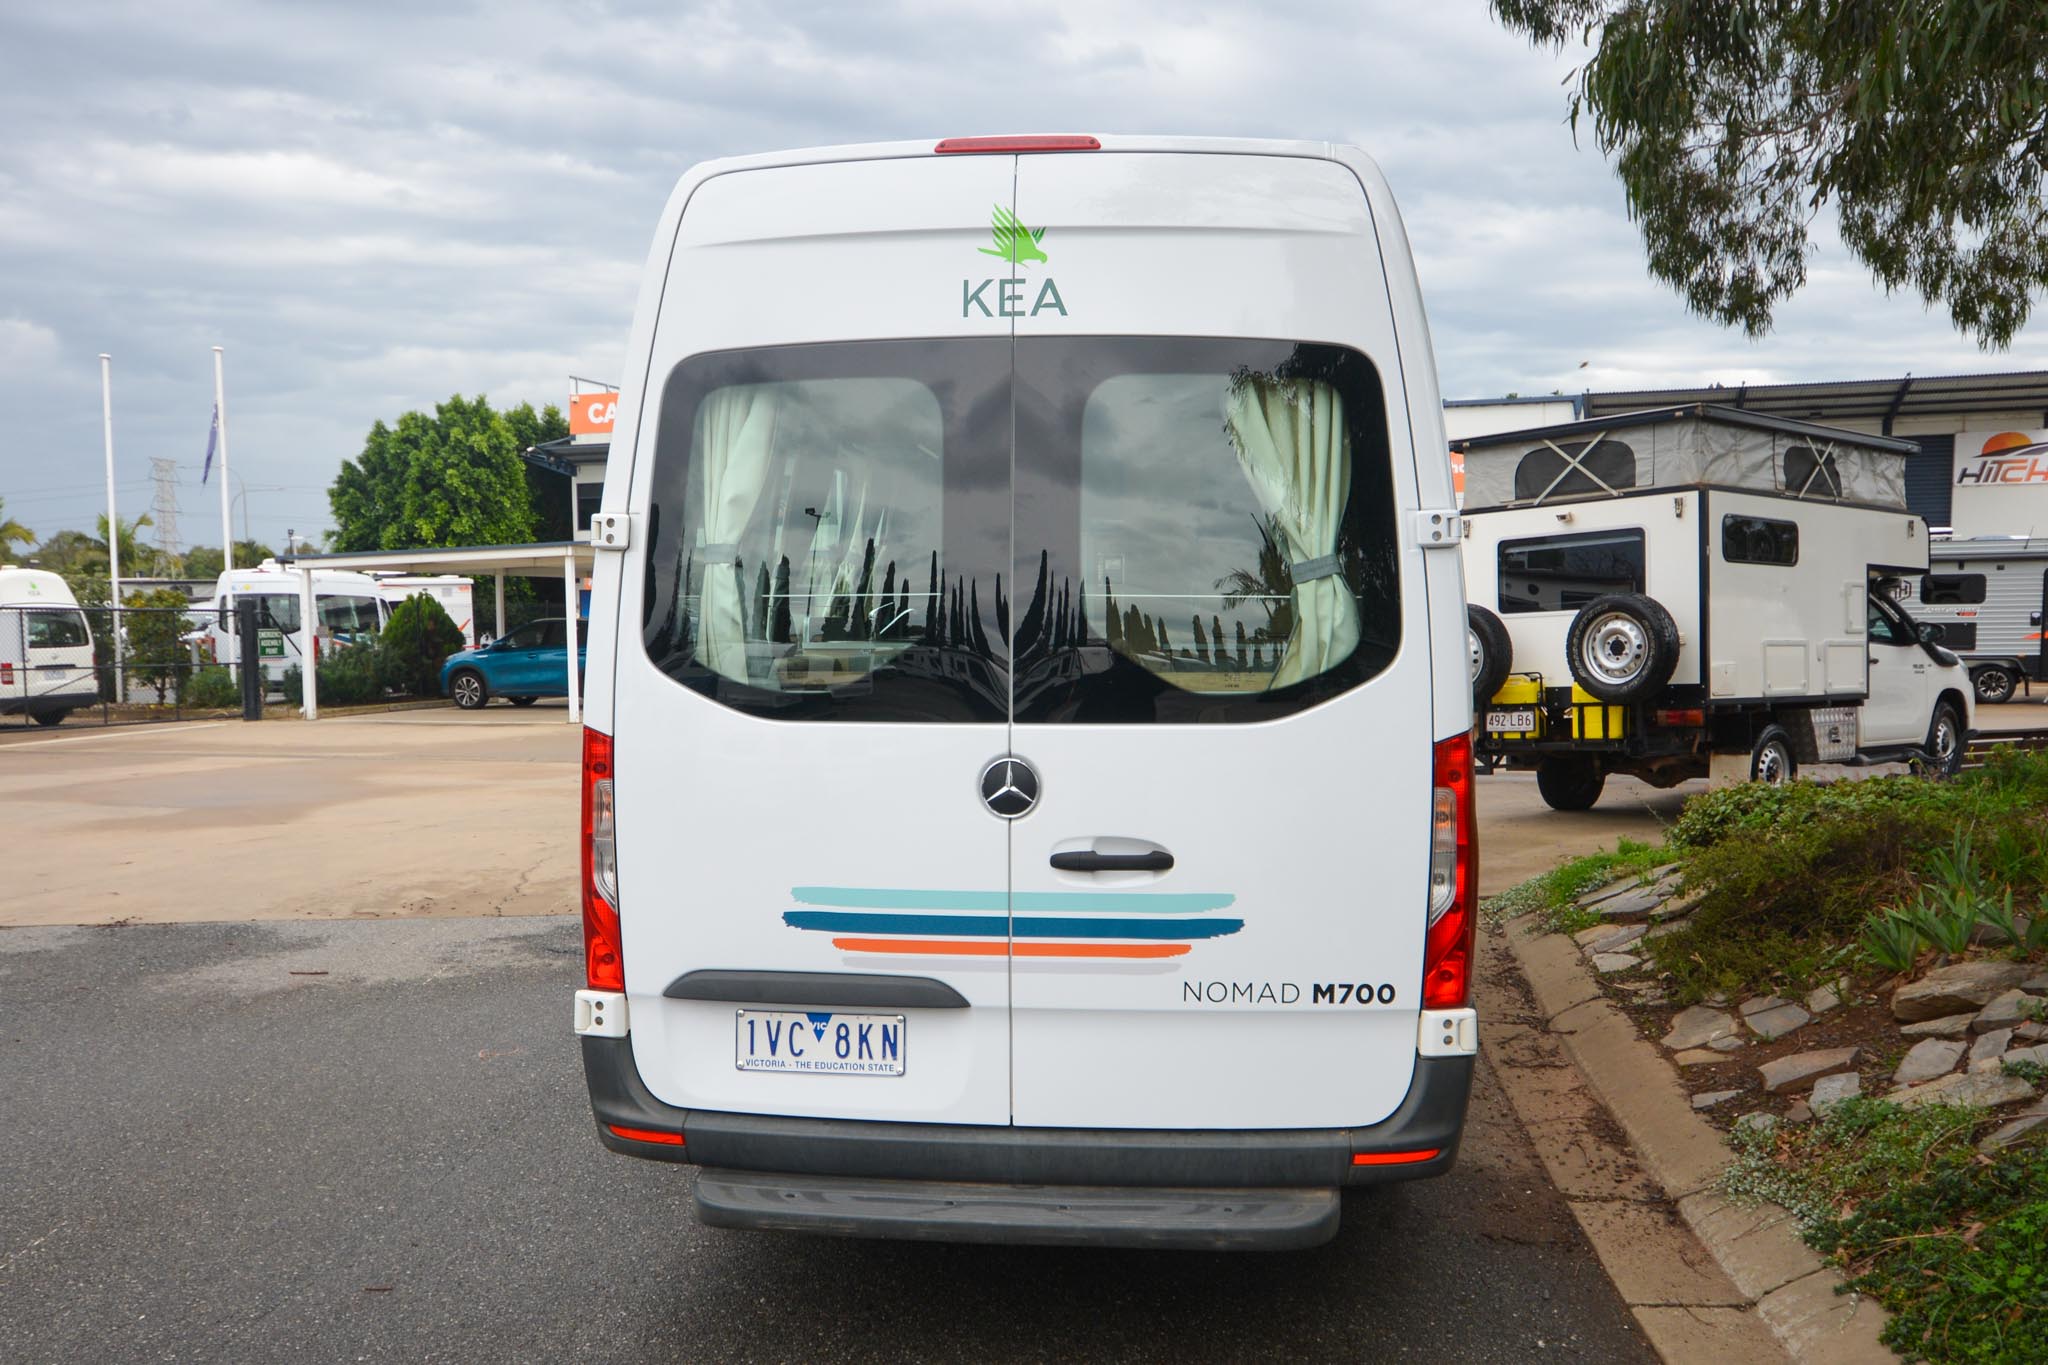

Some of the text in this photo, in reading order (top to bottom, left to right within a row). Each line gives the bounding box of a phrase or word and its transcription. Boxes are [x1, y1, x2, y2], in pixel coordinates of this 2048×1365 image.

[963, 278, 1068, 317] KEA
[260, 639, 282, 647] ASSEMBLY
[1184, 981, 1396, 1004] NOMAD M700
[811, 1021, 827, 1030] VIC
[747, 1019, 898, 1062] 1VC 8KN
[745, 1058, 786, 1069] VICTORIA
[795, 1060, 812, 1069] THE
[814, 1061, 865, 1072] EDUCATION
[868, 1063, 895, 1073] STATE
